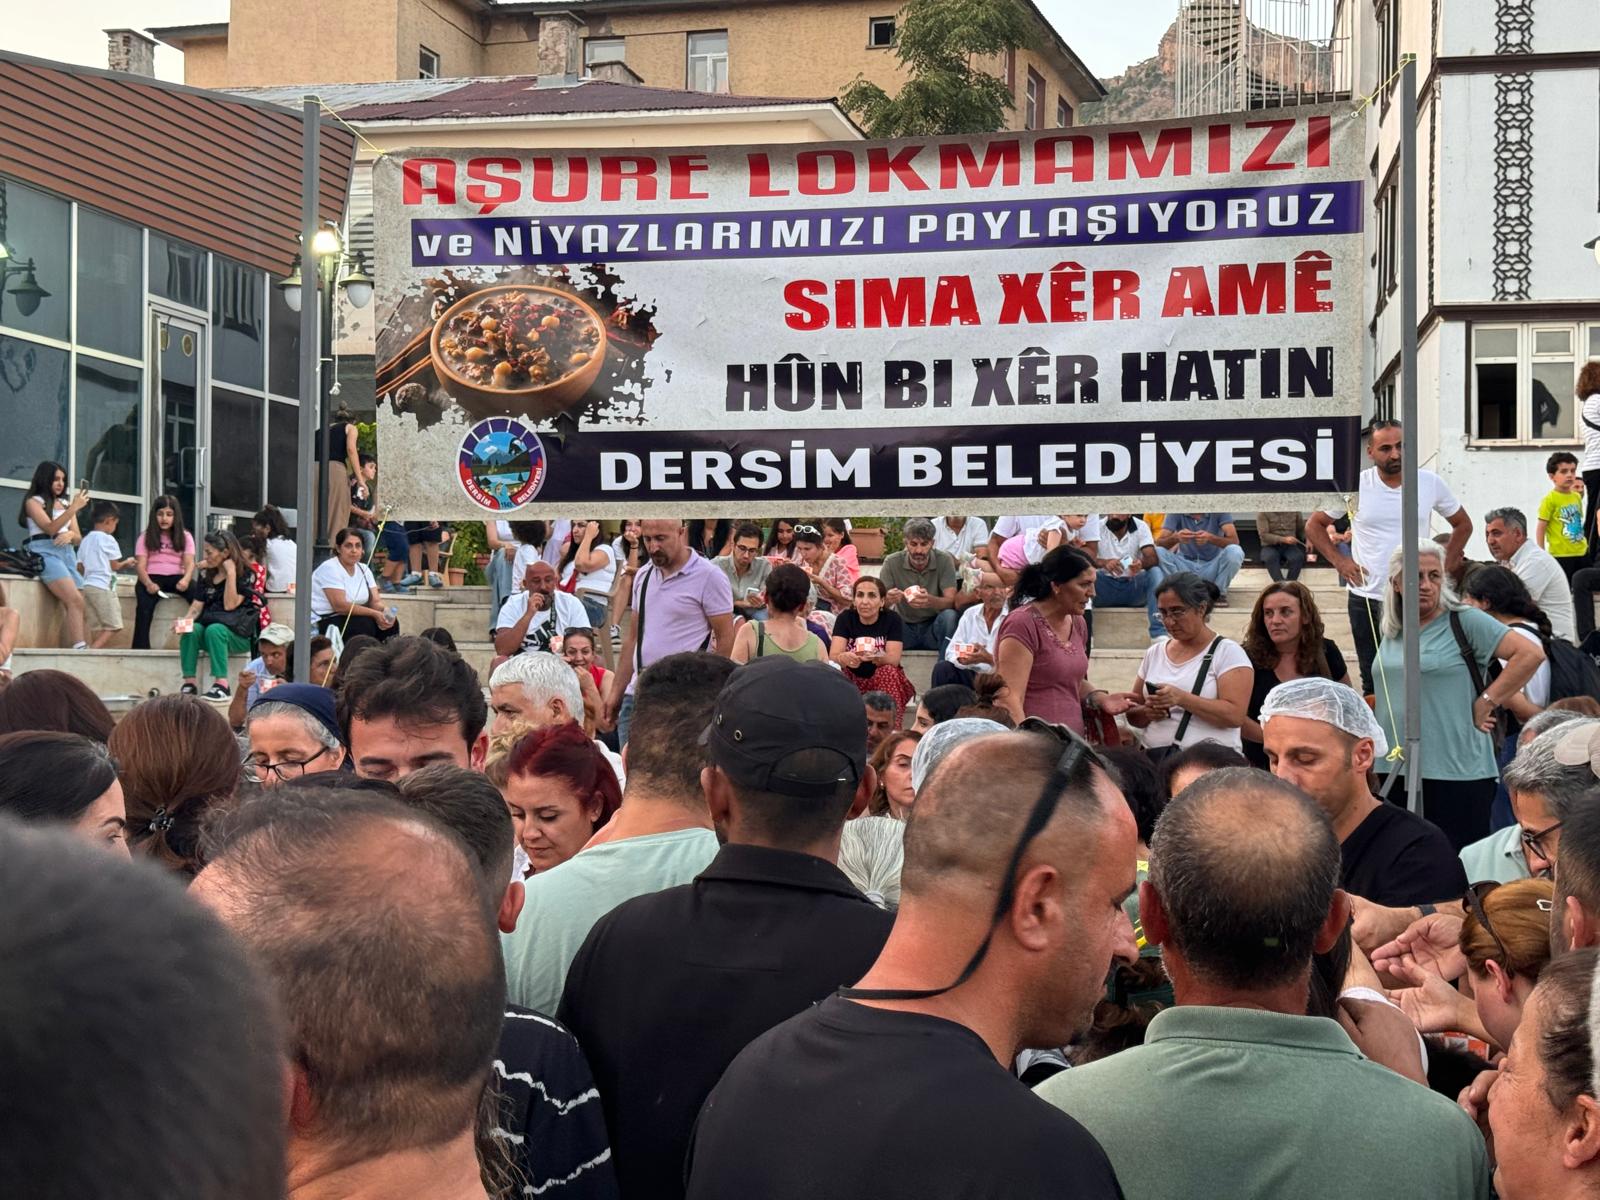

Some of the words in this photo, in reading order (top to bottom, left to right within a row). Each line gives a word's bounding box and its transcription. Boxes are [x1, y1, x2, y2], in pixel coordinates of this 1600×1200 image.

[402, 155, 709, 215] AŞURE
[748, 116, 1331, 198] LOKMAMIZI
[417, 233, 474, 257] ve
[494, 216, 886, 256] NİYAZLARIMIZI
[908, 193, 1335, 243] PAYLAŞIYORUZ
[783, 275, 981, 332] SIMA
[998, 261, 1141, 325] XÊR
[1161, 250, 1334, 318] AMÊ
[725, 352, 863, 412] HÛN
[884, 358, 953, 409] BI
[971, 346, 1099, 407] XÊR
[1120, 345, 1334, 403] HATIN
[600, 439, 871, 491] DERSİM
[898, 428, 1334, 487] BELEDİYESİ
